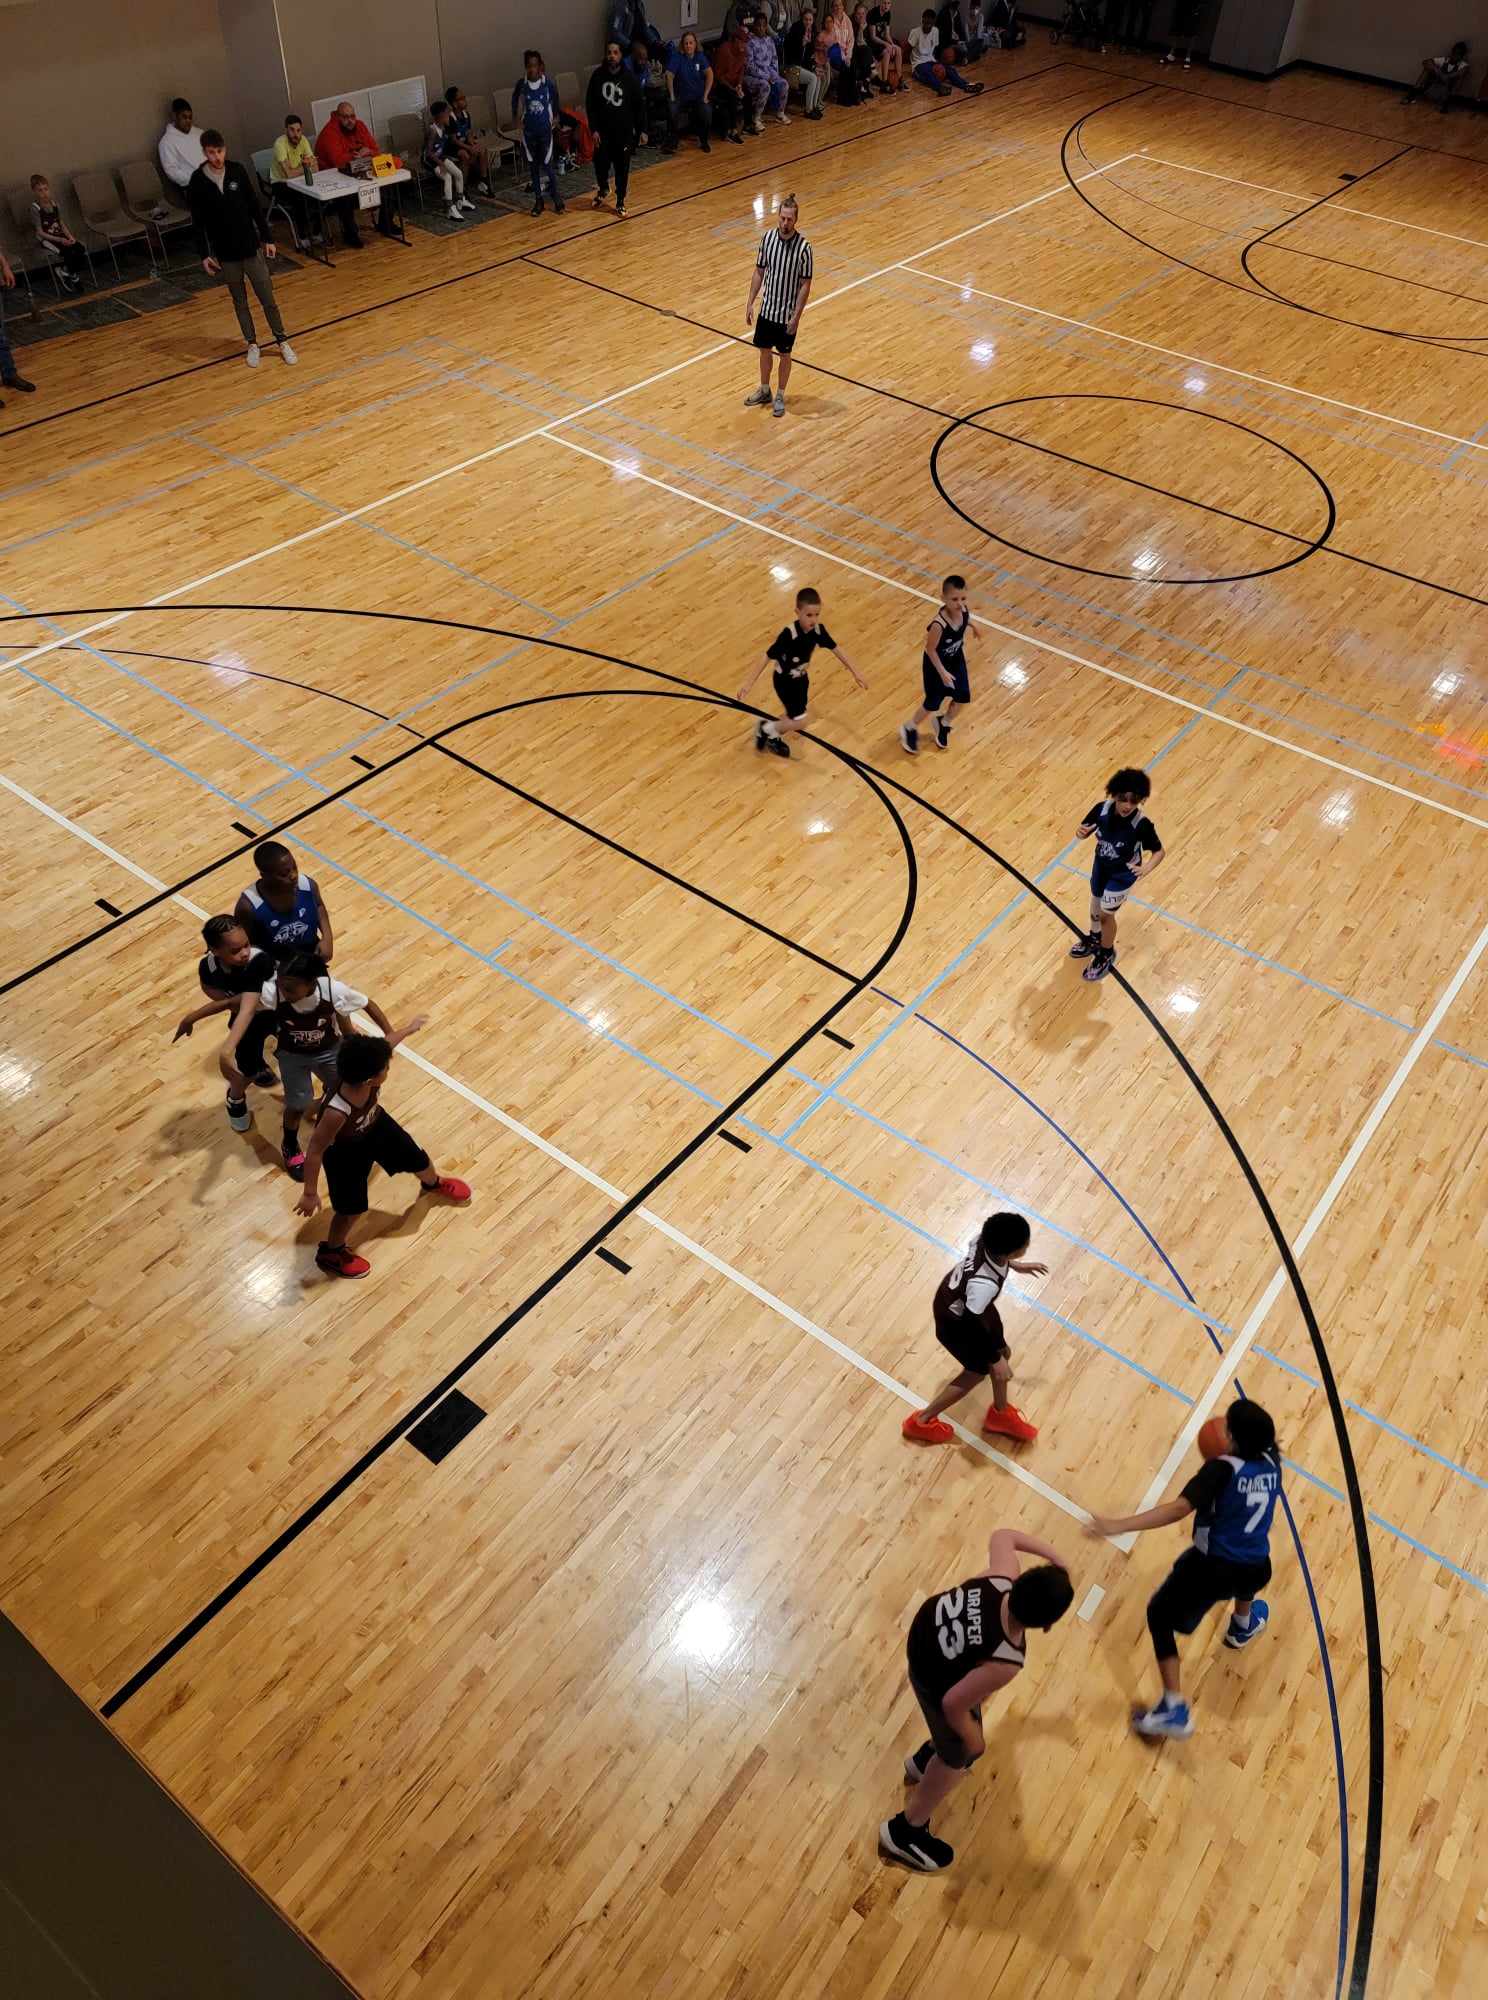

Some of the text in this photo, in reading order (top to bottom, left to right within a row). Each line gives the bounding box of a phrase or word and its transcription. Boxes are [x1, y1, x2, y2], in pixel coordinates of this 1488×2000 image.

[1243, 1491, 1270, 1534] 7
[935, 1587, 965, 1660] 23
[966, 1587, 983, 1646] DRAPER
